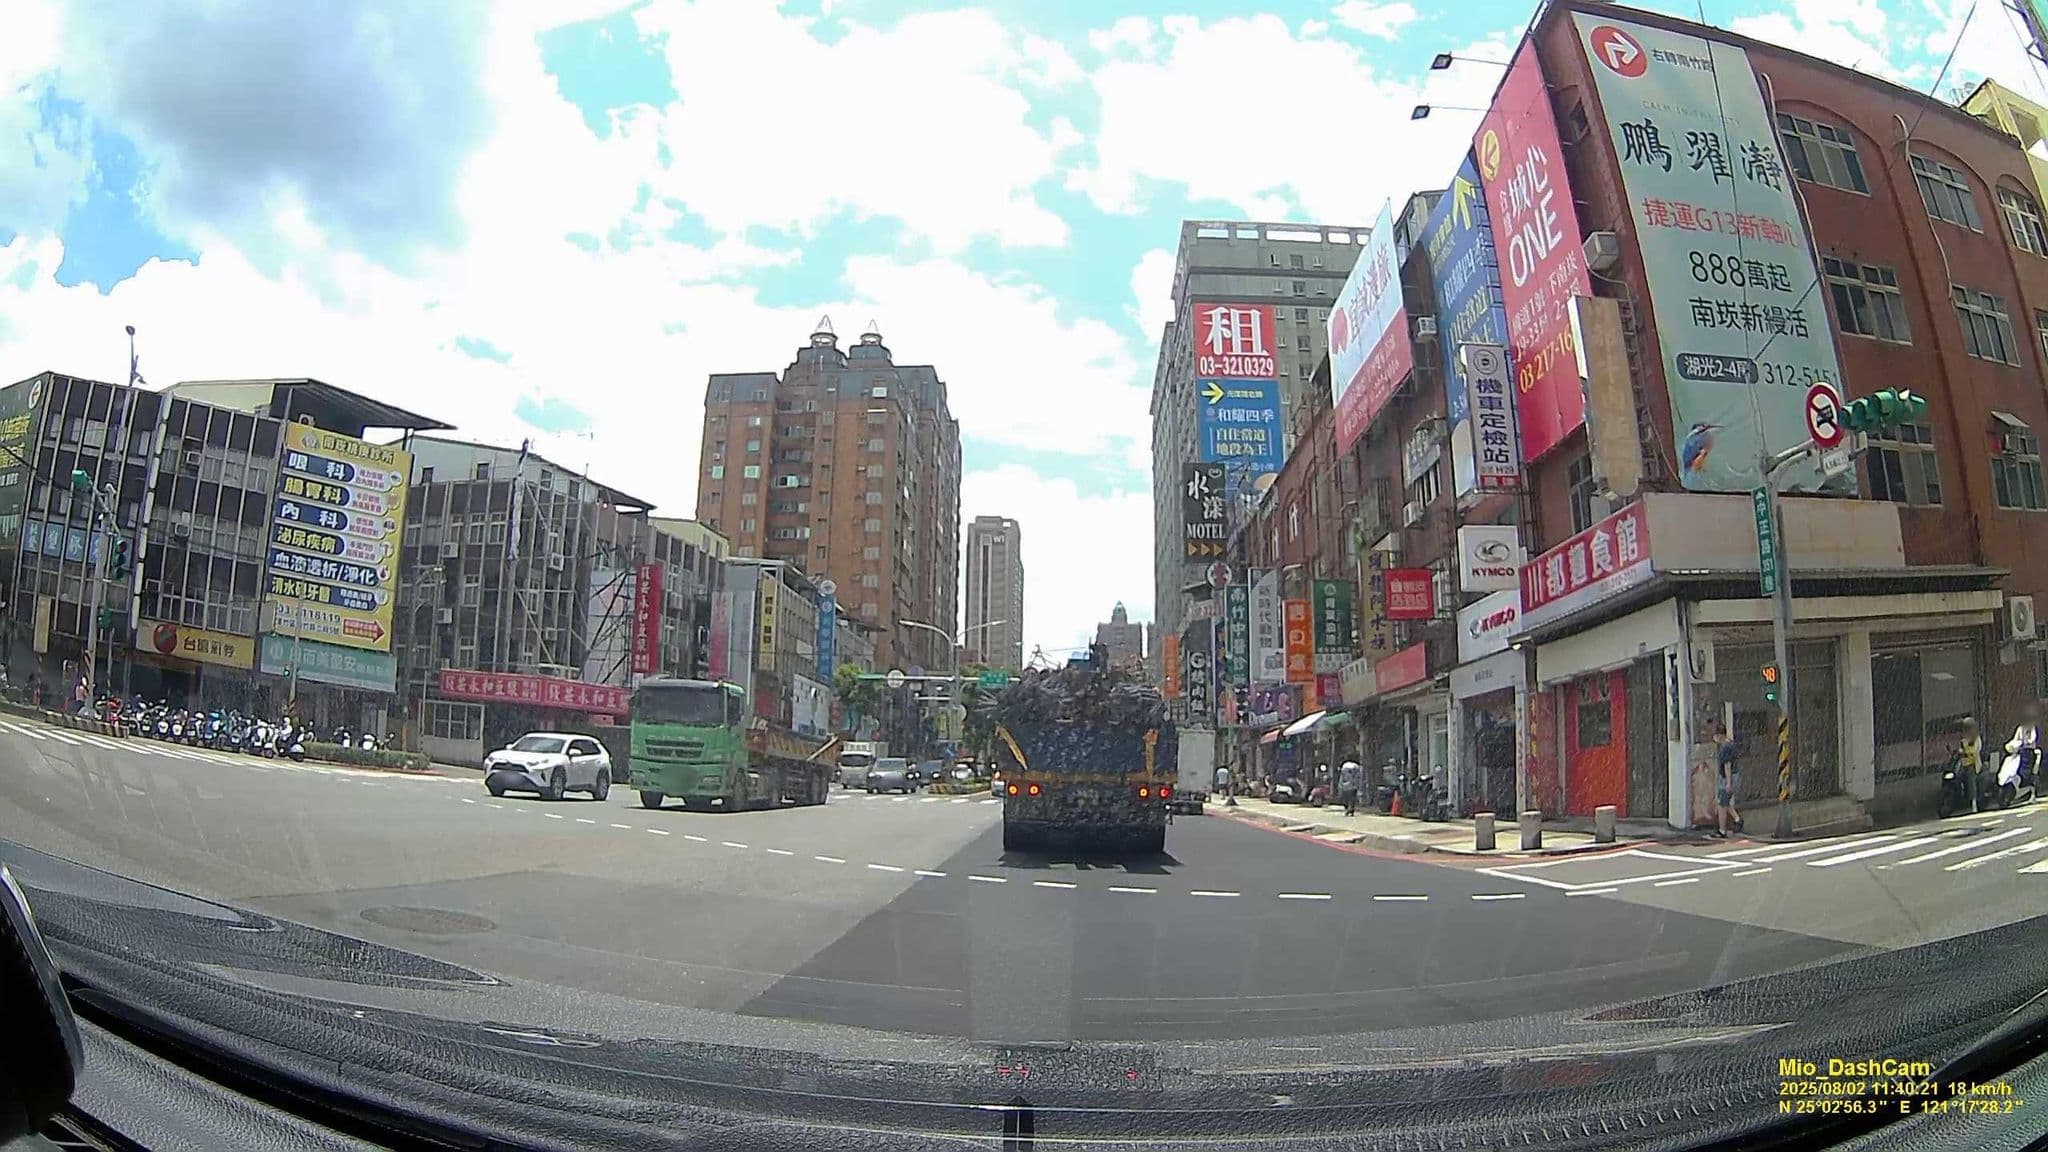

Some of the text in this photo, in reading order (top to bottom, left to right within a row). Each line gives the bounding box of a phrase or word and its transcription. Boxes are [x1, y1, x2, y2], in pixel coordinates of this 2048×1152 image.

[1652, 48, 1714, 73] 右轉南竹路
[1642, 197, 1800, 248] 捷運G13新軸心
[1510, 189, 1563, 288] ONE
[1689, 250, 1793, 293] 888萬起
[1203, 306, 1270, 356] 租
[1688, 297, 1810, 340] 南崁新縵活
[1200, 356, 1274, 377] 03-3210329
[1476, 377, 1510, 464] 機車定檢站
[288, 452, 345, 480] 眼科
[284, 476, 342, 504] 腸胃科
[281, 502, 338, 529] 內科
[277, 526, 336, 553] 泌尿疾病
[1186, 522, 1226, 539] MOTEL
[274, 551, 375, 586] 血液透析/淨化
[1471, 567, 1515, 578] KYMCO
[1481, 607, 1516, 633] KYMCO
